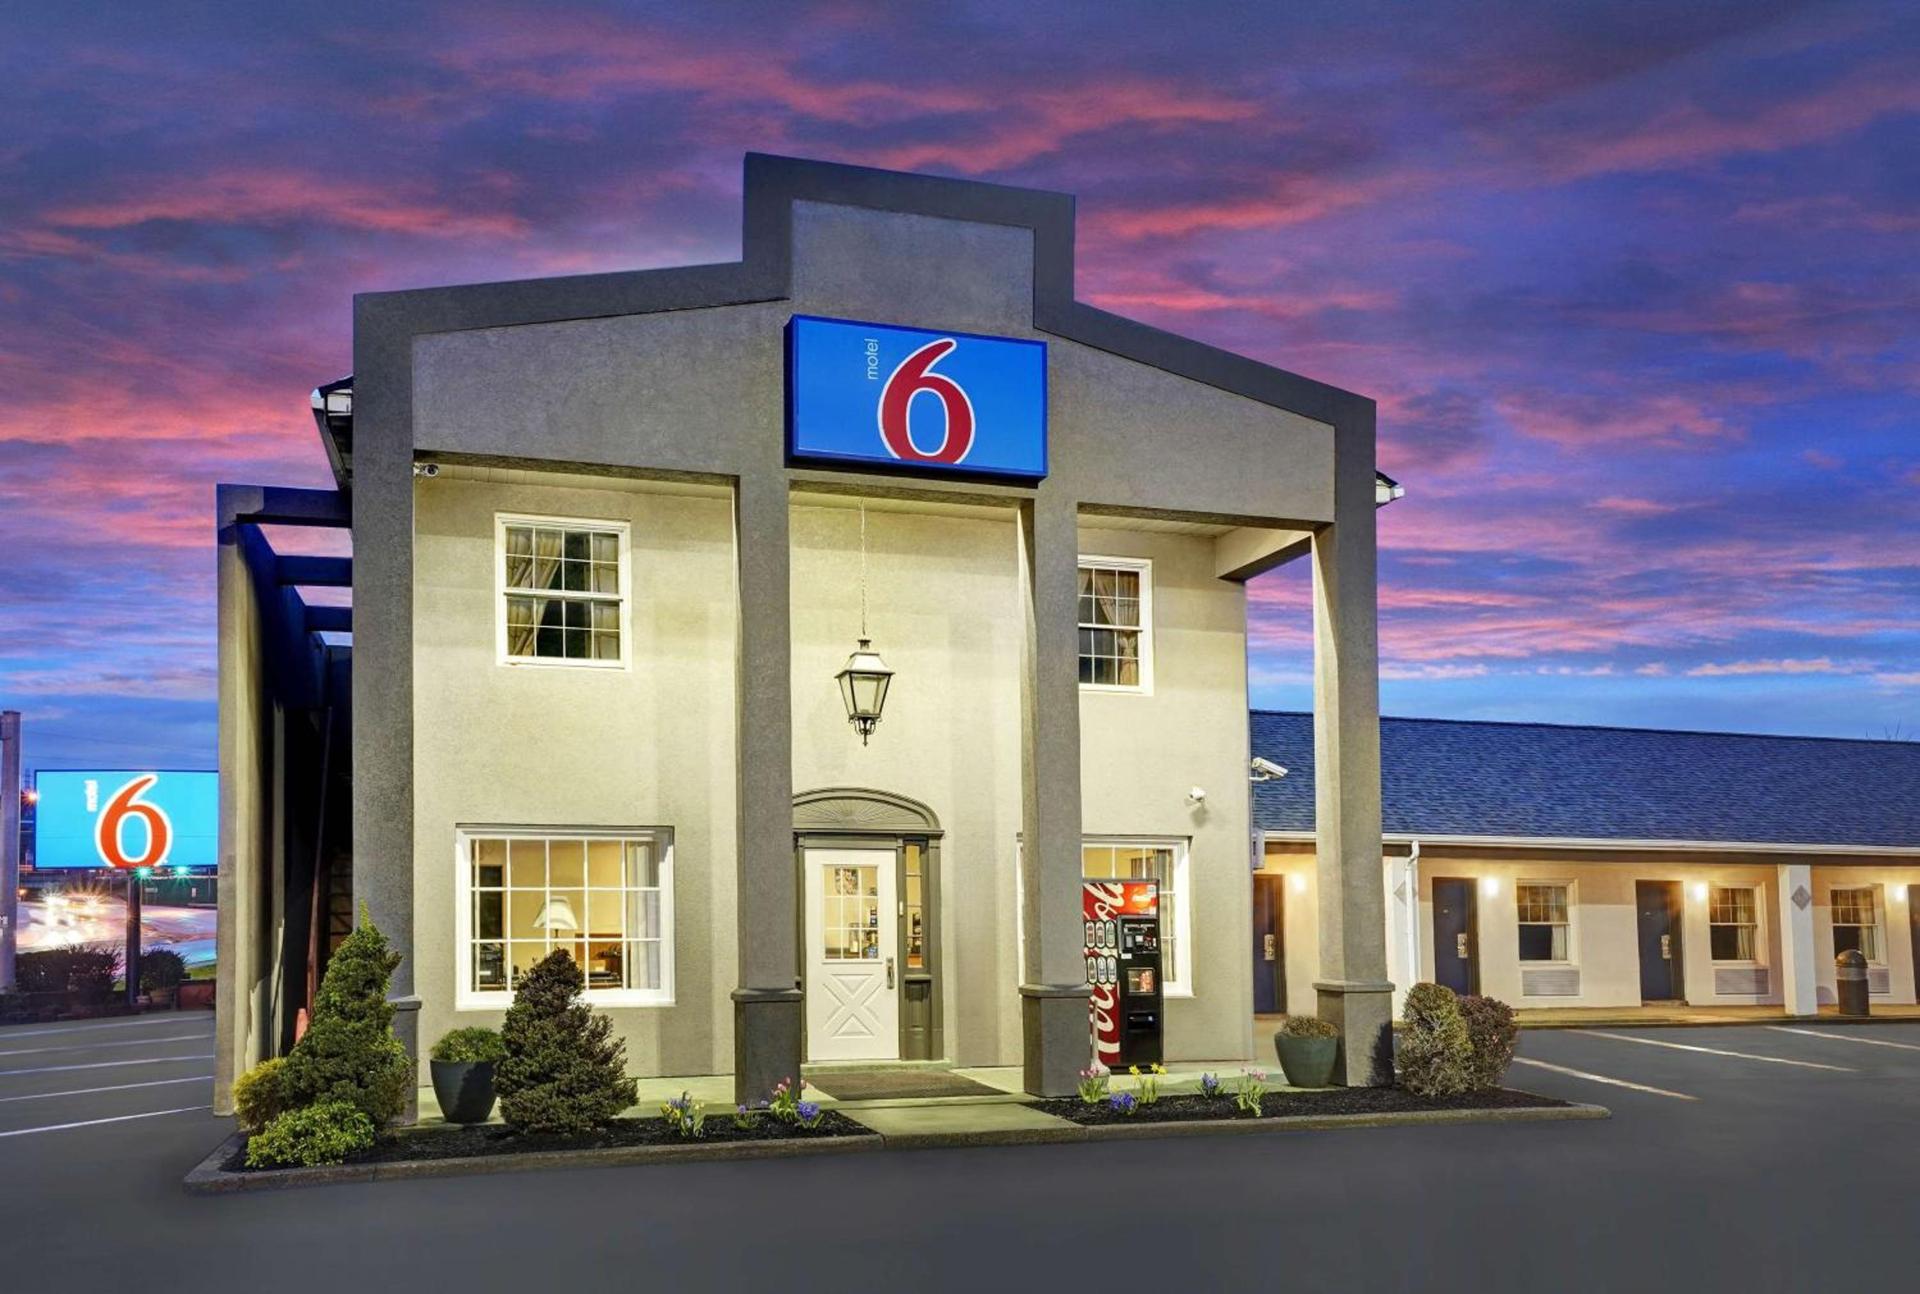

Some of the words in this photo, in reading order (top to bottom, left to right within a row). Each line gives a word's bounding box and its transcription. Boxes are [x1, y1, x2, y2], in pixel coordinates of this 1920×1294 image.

[864, 338, 880, 380] motel
[877, 337, 976, 465] 6
[95, 774, 173, 867] 6
